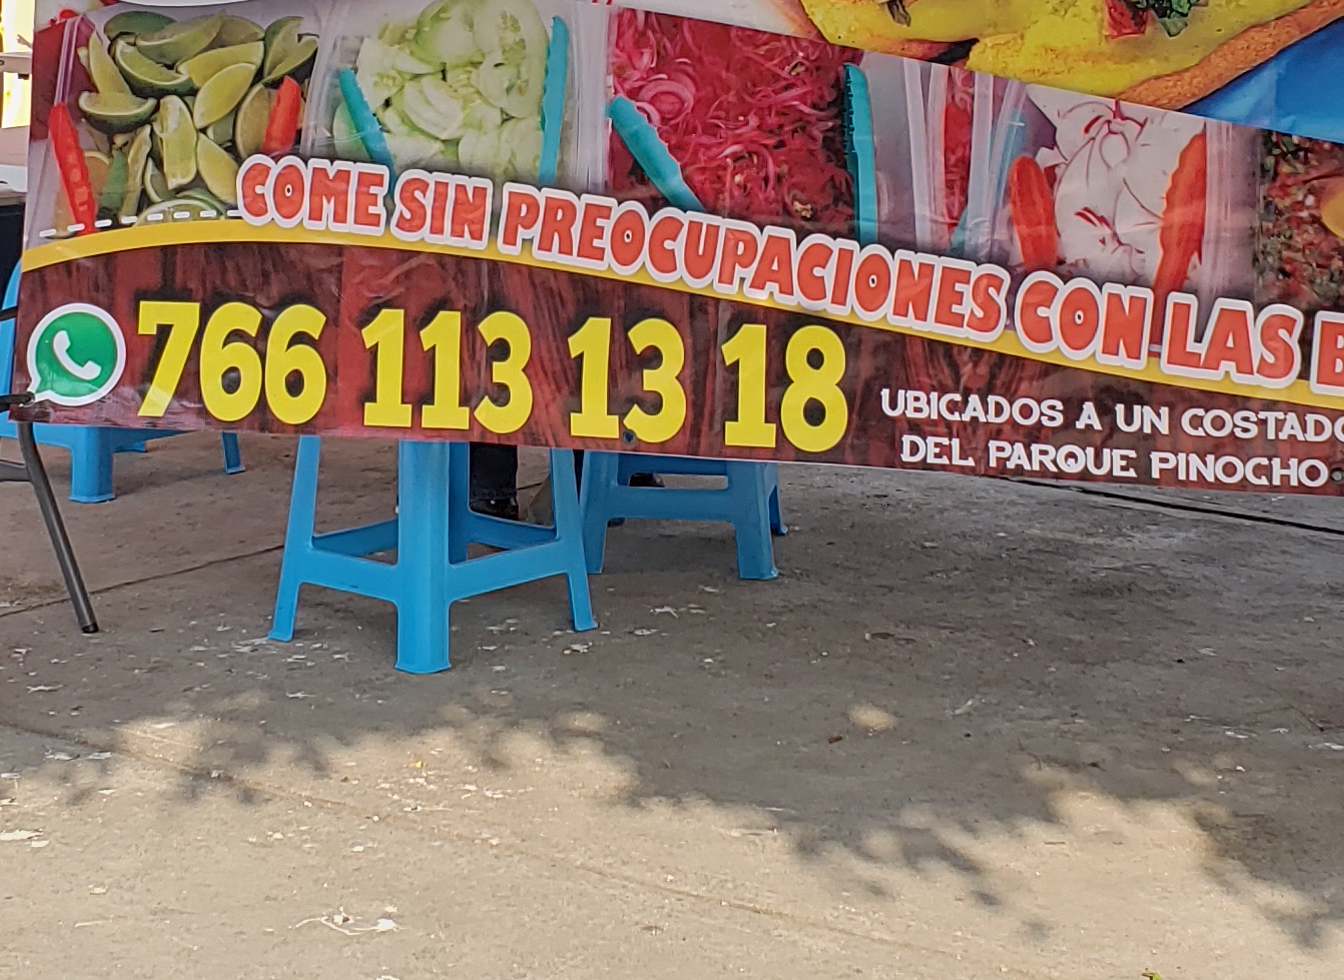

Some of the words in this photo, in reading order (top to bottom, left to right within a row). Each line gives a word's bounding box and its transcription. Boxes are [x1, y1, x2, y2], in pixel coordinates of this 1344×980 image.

[238, 156, 390, 231] COME
[394, 170, 494, 248] SIN
[502, 183, 1009, 341] PREOCUPACIONES
[1016, 272, 1152, 370] CON
[1161, 293, 1303, 387] LAS
[137, 300, 327, 424] 766
[362, 308, 533, 433] 113
[568, 317, 687, 443] 13
[721, 323, 849, 453] 18
[881, 388, 1064, 428] UBICADOS
[1076, 401, 1102, 431] A
[1115, 404, 1170, 436] UN
[901, 433, 974, 467] DEL
[988, 439, 1137, 478] PARQUE
[1150, 451, 1329, 488] PINOCHO
